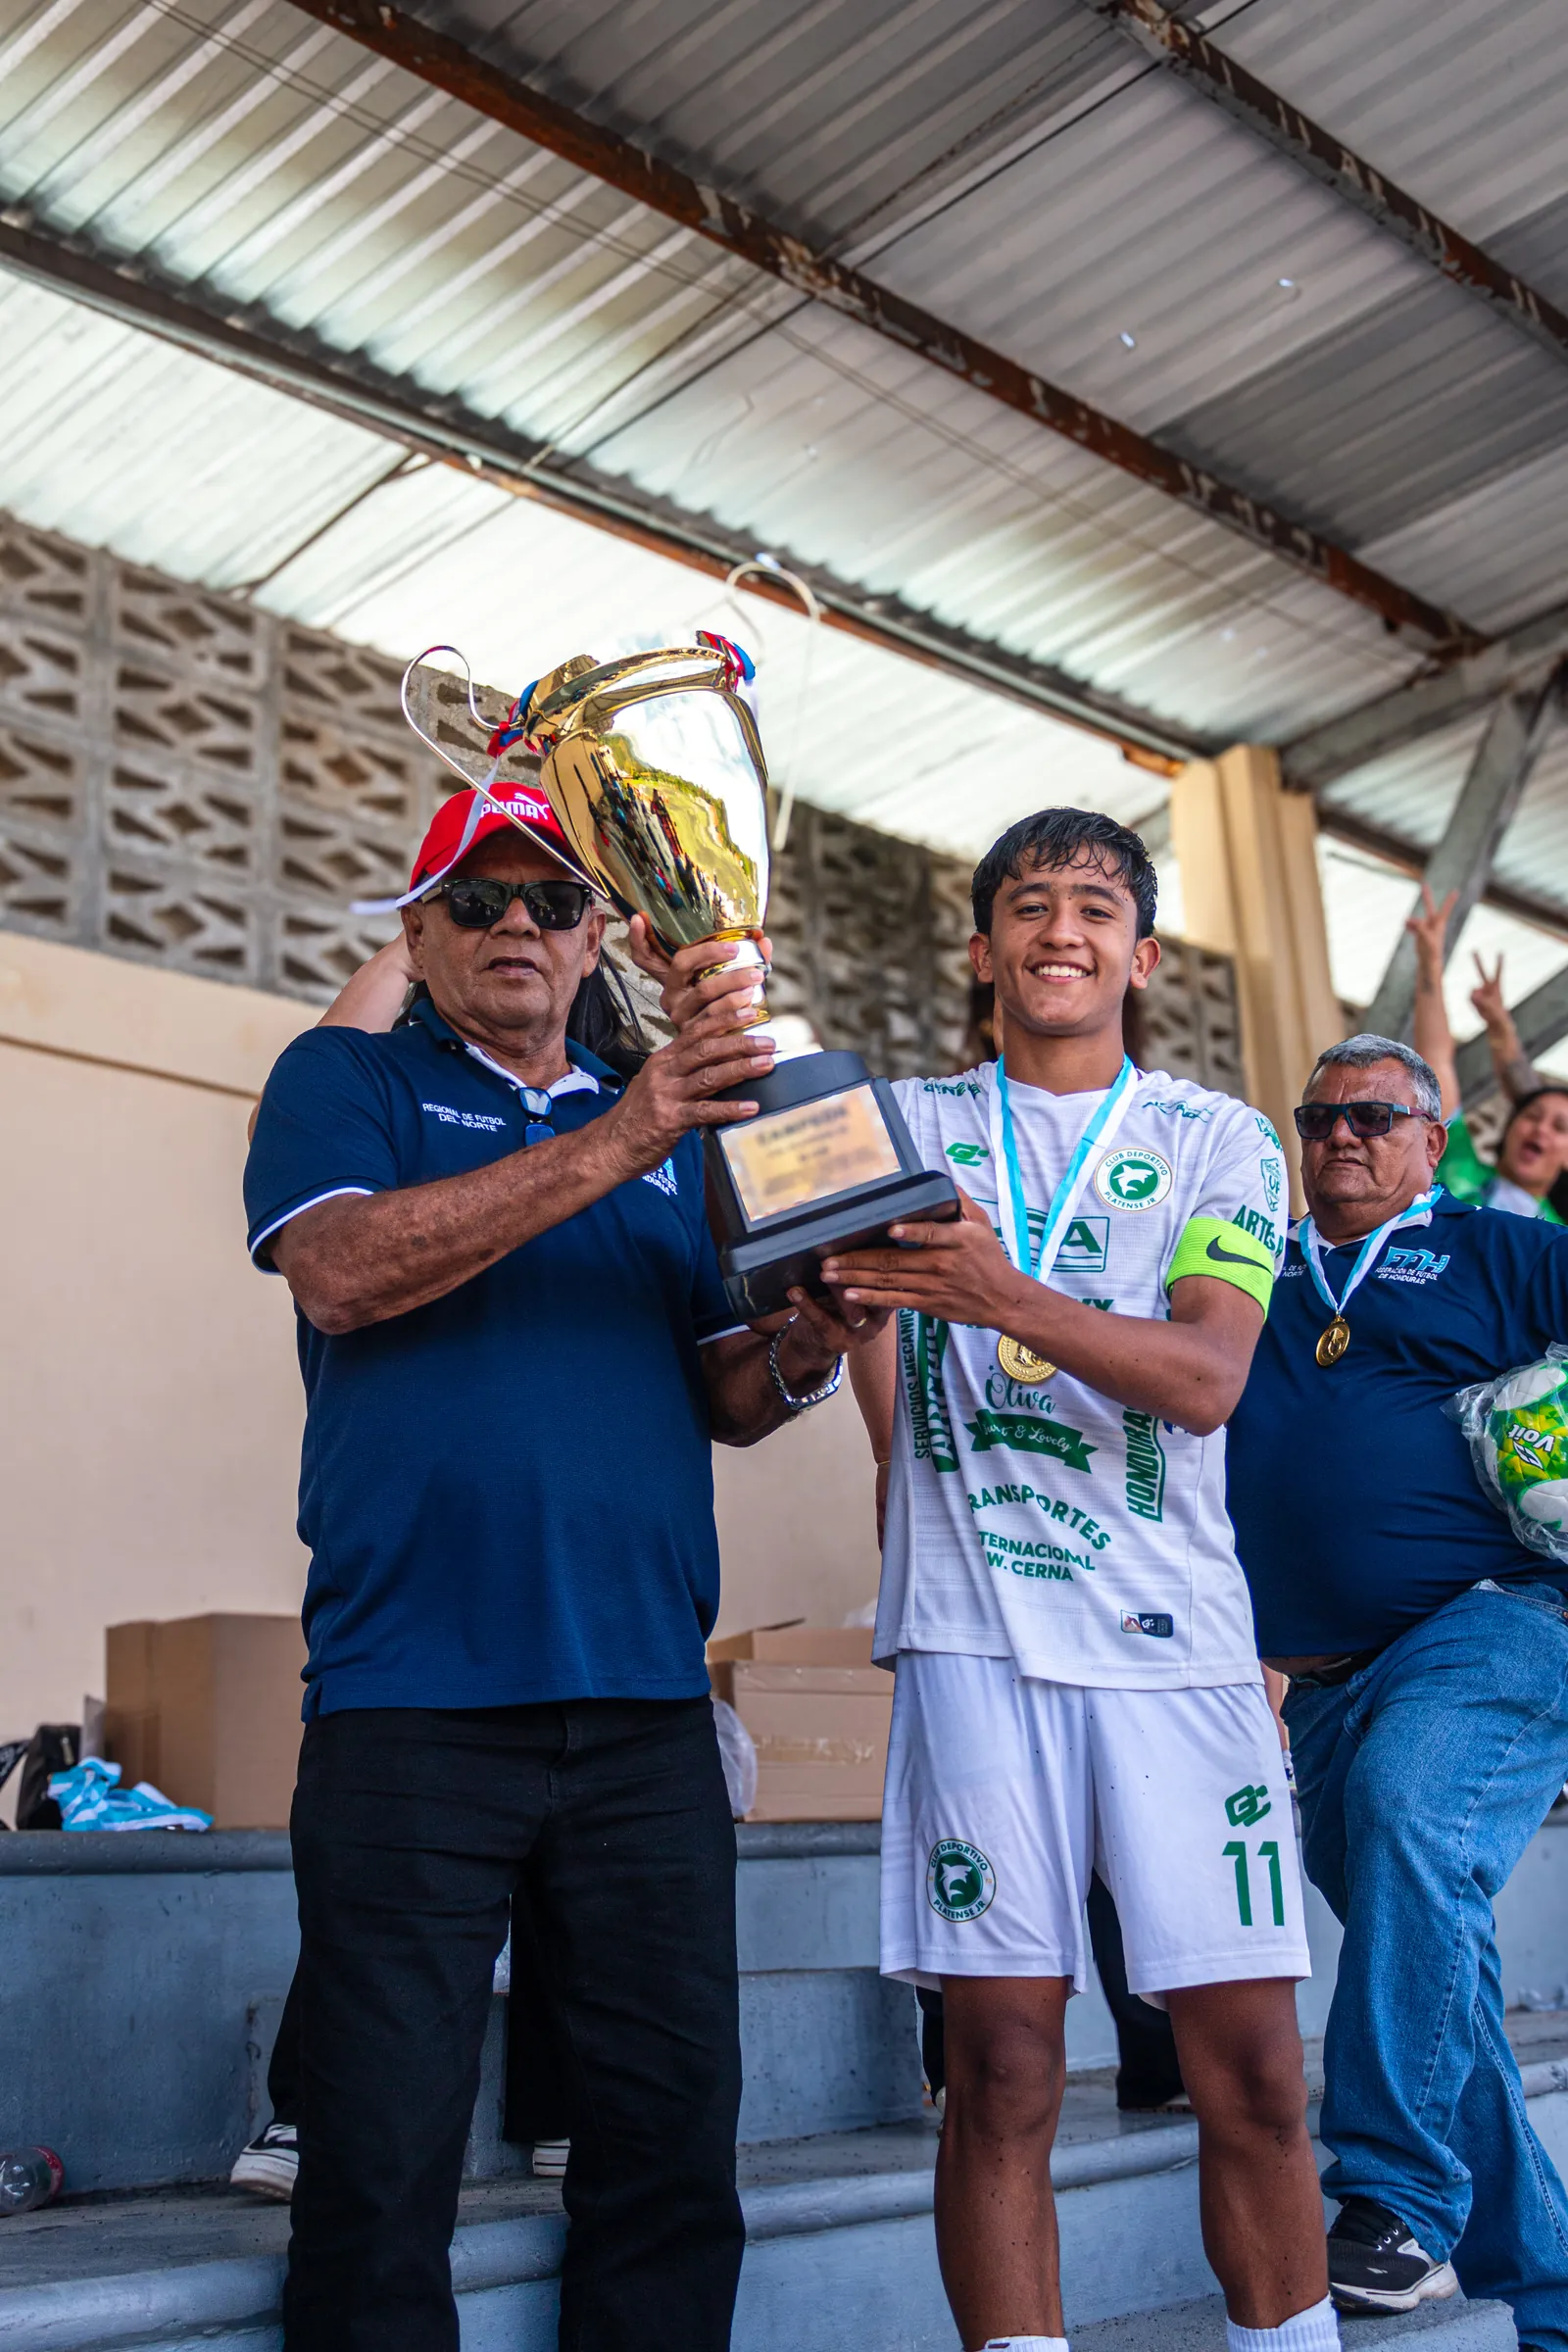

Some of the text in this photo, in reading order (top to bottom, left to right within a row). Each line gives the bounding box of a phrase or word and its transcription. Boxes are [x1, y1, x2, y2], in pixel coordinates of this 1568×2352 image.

[422, 1102, 461, 1118] REGIONAL
[438, 1113, 498, 1132] DEL NORTE
[1105, 1151, 1168, 1176] CLUB DEPORTIVO
[1104, 1191, 1156, 1209] PLATENSE JR
[1388, 1275, 1427, 1285] HONDURAS
[899, 1308, 918, 1378] MECANIC
[985, 1373, 1056, 1414] Oliva
[1014, 1425, 1026, 1439] &
[1028, 1426, 1072, 1452] Lovely
[1507, 1423, 1555, 1452] Voit
[1122, 1405, 1159, 1519] HONDURA
[967, 1484, 1111, 1550] RANSPORTES
[978, 1531, 1096, 1570] TERNACIONAL
[987, 1551, 1074, 1582] W. CERNA
[930, 1842, 988, 1871] CLUB DEPORTIVO
[1222, 1841, 1285, 1926] 11
[934, 1899, 986, 1919] PLATENSE JR
